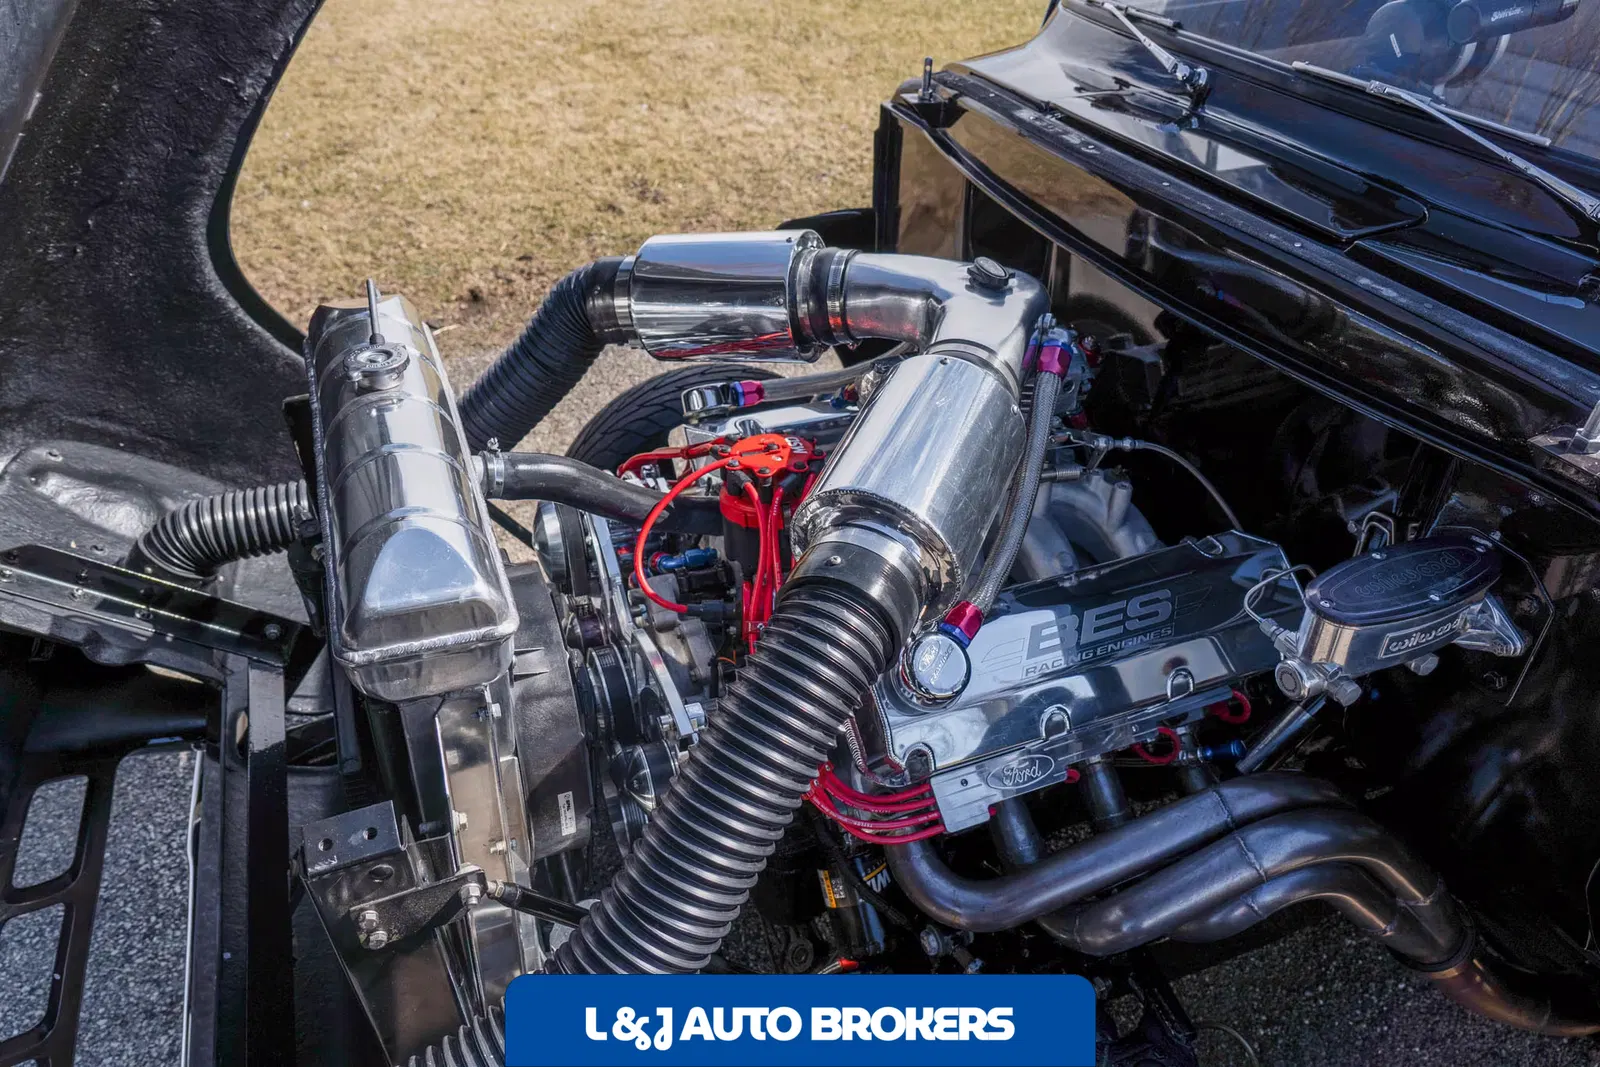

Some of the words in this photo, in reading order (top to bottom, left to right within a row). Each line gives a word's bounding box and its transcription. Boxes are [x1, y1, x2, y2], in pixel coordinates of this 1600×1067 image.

[784, 436, 808, 454] MSD
[1026, 589, 1172, 660] BES
[1025, 649, 1094, 677] RACING
[1096, 627, 1172, 657] ENGINES
[1002, 760, 1042, 786] Ford
